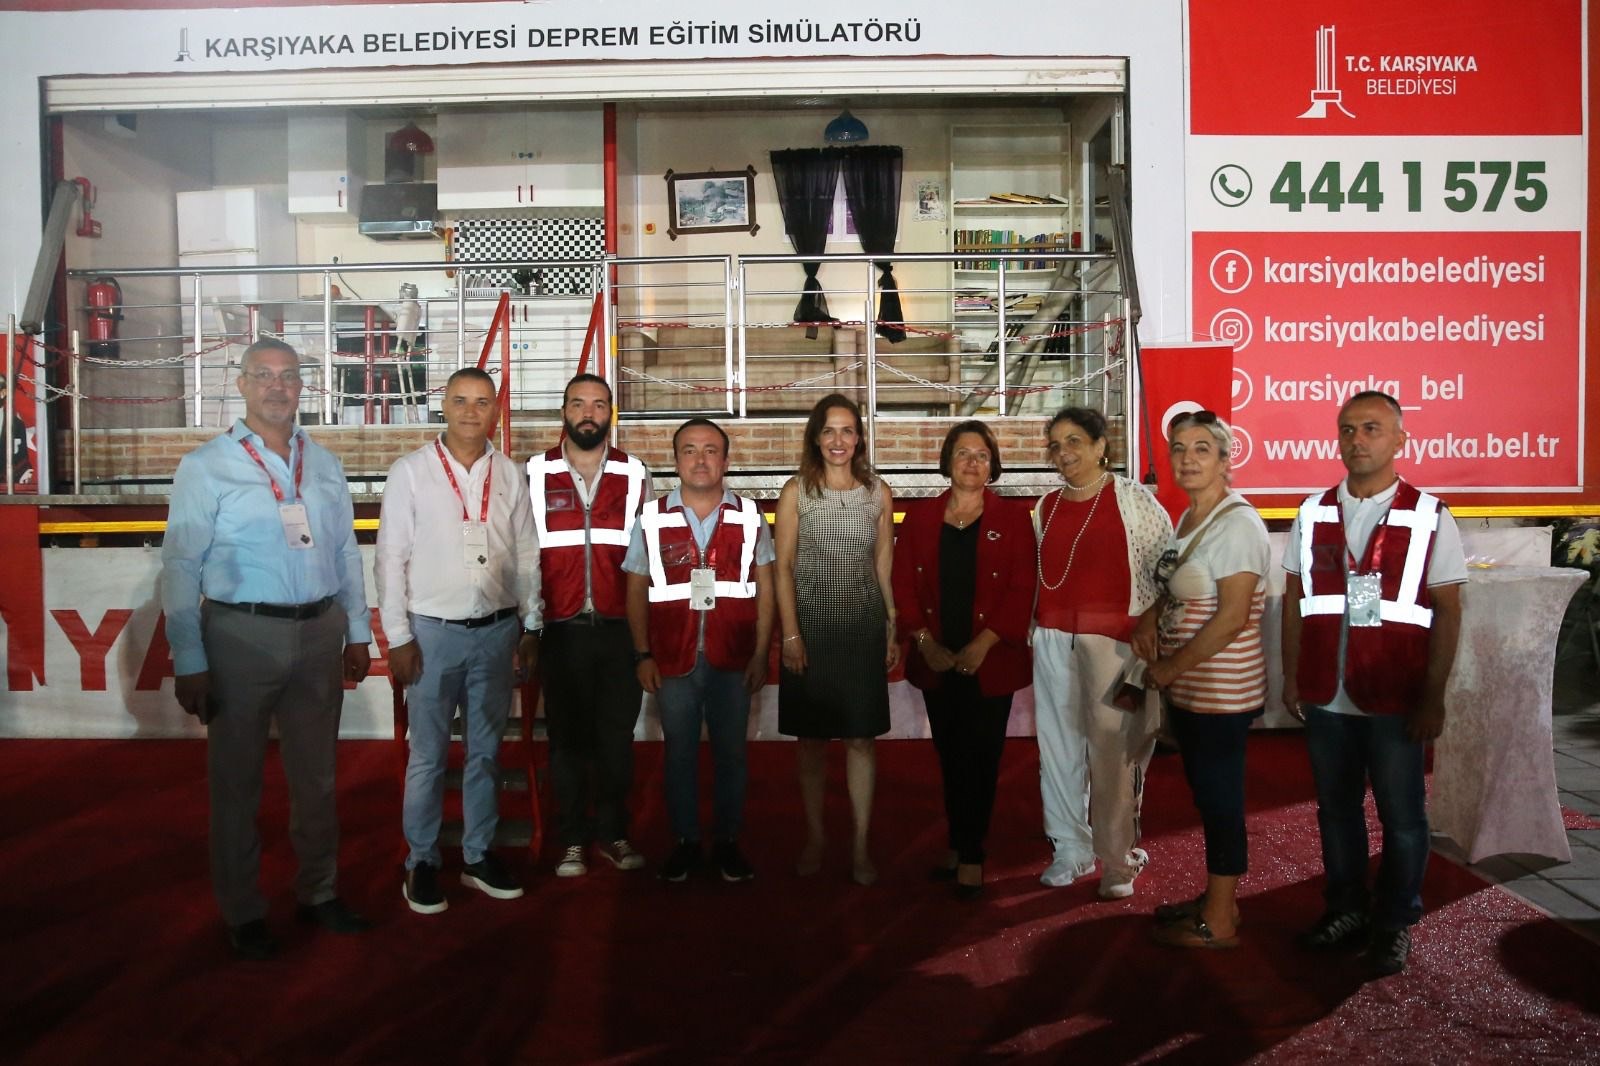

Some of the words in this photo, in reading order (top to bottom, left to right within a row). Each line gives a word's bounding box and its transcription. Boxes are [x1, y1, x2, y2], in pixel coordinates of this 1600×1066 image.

[206, 34, 354, 61] KARŞIYAKA
[363, 24, 517, 53] BELEDİYESİ
[528, 26, 638, 48] DEPREM
[649, 20, 738, 46] EĞİTİM
[748, 17, 922, 44] SİMÜLATÖRÜ
[1345, 55, 1376, 72] T.C.
[1380, 55, 1478, 75] KARŞIYAKA
[1366, 75, 1457, 95] BELEDİYESİ
[1269, 161, 1384, 213] 444
[1402, 161, 1422, 213] 1
[1443, 160, 1548, 213] 575
[1264, 255, 1545, 289] karsiyakabelediyesi
[1264, 313, 1545, 347] karsiyakabelediyesi
